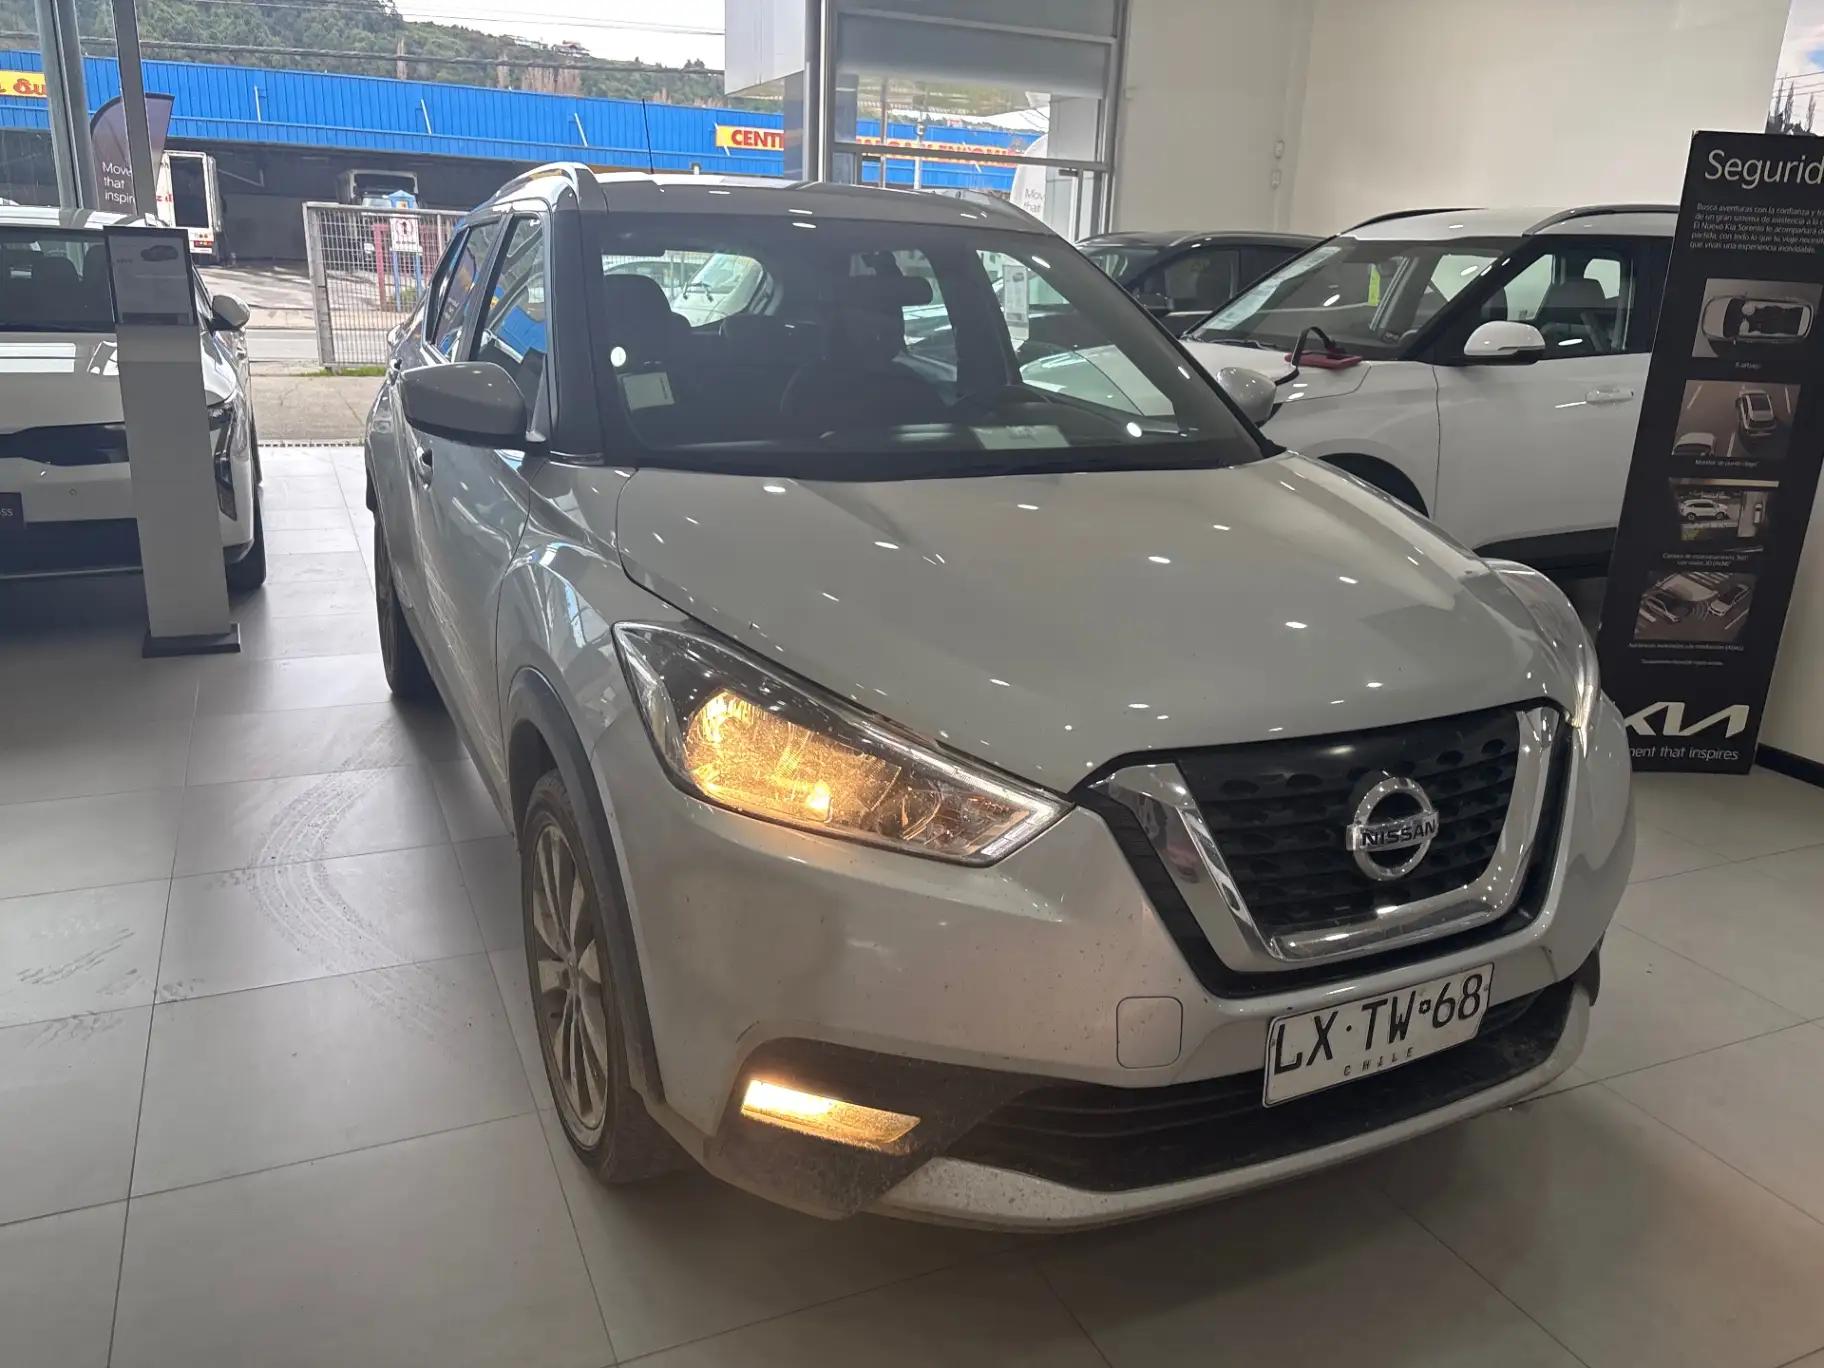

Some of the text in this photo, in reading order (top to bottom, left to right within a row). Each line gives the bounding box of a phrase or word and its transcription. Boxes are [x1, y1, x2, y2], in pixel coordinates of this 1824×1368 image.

[104, 177, 125, 189] that
[1660, 746, 1684, 759] that
[1688, 747, 1739, 761] inspires
[1361, 818, 1437, 847] NISSAN
[1342, 1046, 1414, 1077] CHILE
